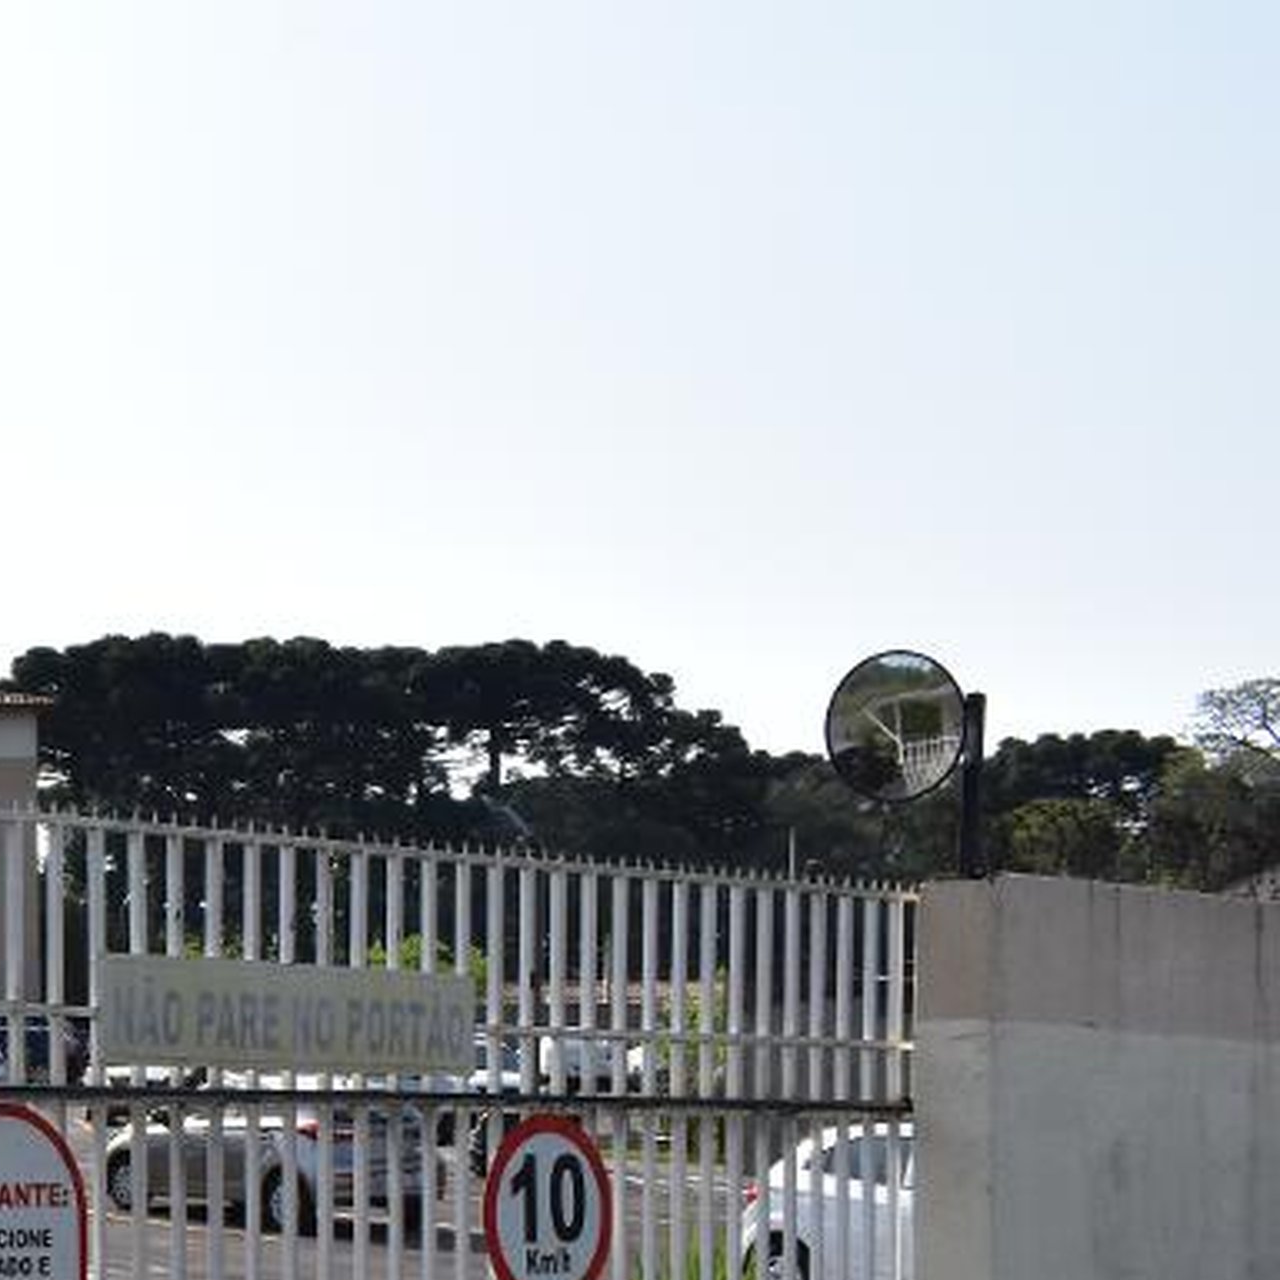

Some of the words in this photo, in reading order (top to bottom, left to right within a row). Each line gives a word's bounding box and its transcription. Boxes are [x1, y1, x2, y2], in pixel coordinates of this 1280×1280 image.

[110, 976, 184, 1049] NÃO
[195, 988, 282, 1052] PARE
[292, 992, 337, 1054] NO
[345, 989, 468, 1060] PORTÃO
[510, 1152, 586, 1244] 10
[38, 1255, 51, 1276] E
